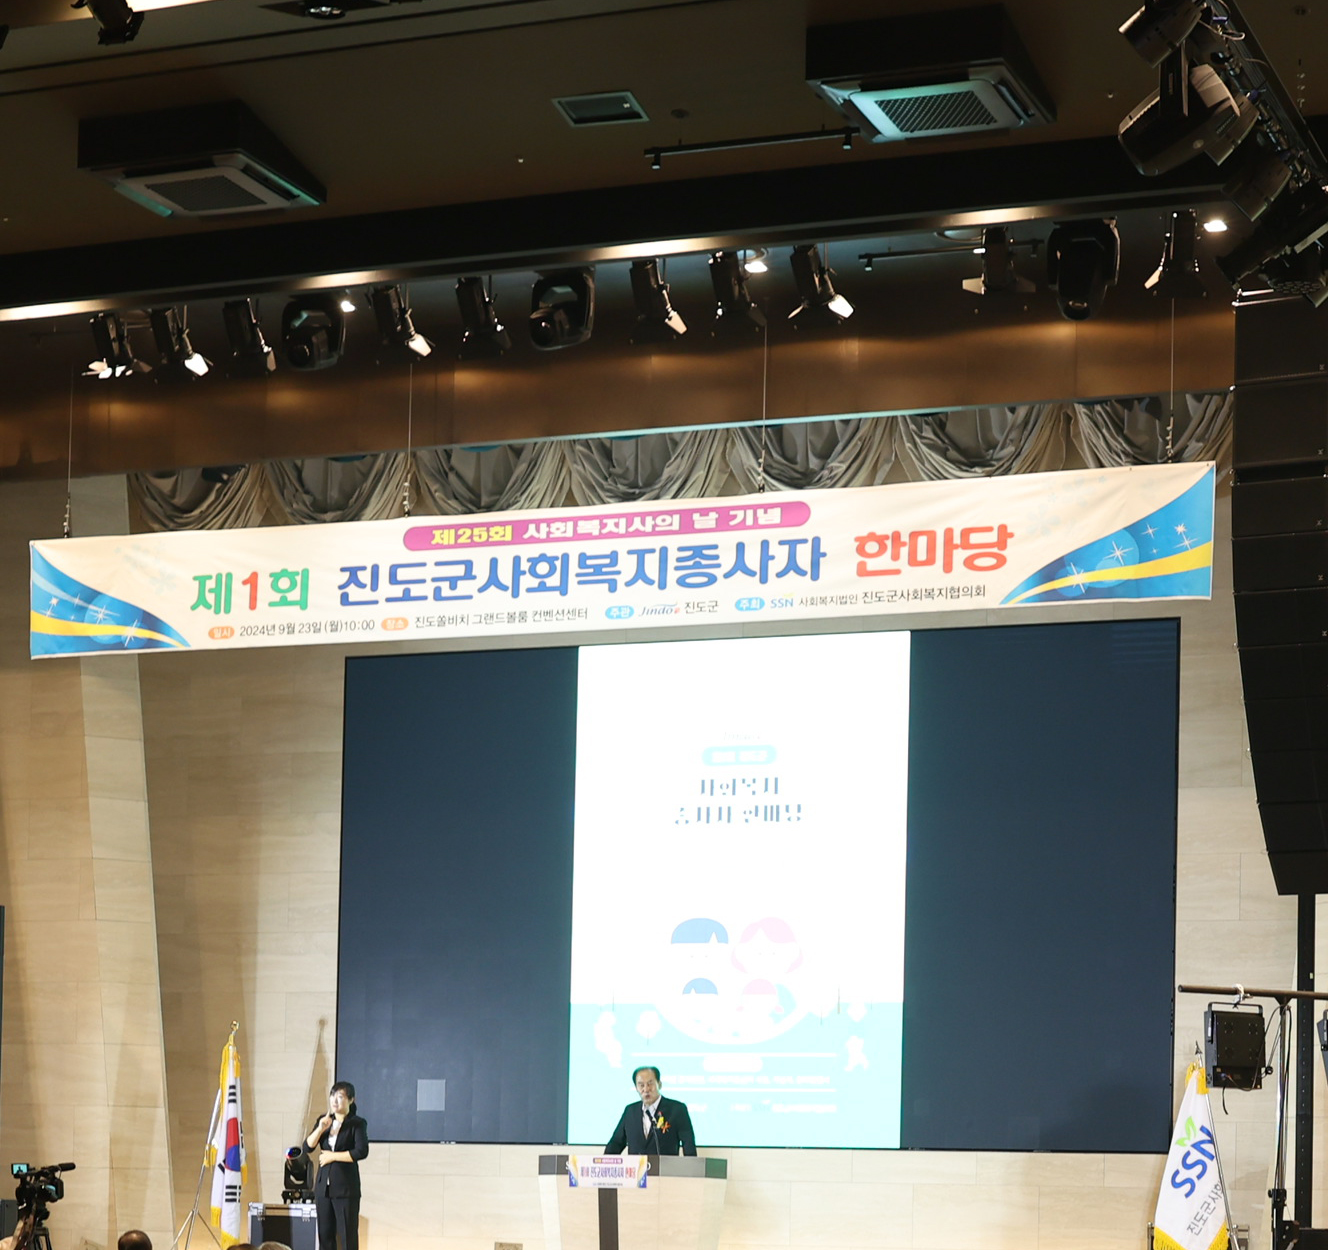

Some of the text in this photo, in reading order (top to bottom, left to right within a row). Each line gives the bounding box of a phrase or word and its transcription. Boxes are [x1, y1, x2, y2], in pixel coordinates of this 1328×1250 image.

[430, 504, 782, 546] 제25회 사회복지사의 날 기념
[190, 522, 1016, 616] 제1회 진도군사회복지종사자 한마당
[239, 625, 275, 637] 2024년
[278, 623, 296, 636] 9월
[298, 621, 322, 634] 23일
[472, 610, 528, 626] 그랜드볼룸
[532, 607, 588, 622] 컨벤션센터
[683, 600, 719, 615] 진도군
[770, 597, 794, 609] SSN
[798, 593, 859, 607] 사회복지법인
[861, 584, 986, 605] 진도군사회복지협의회
[1171, 1124, 1216, 1198] SSN
